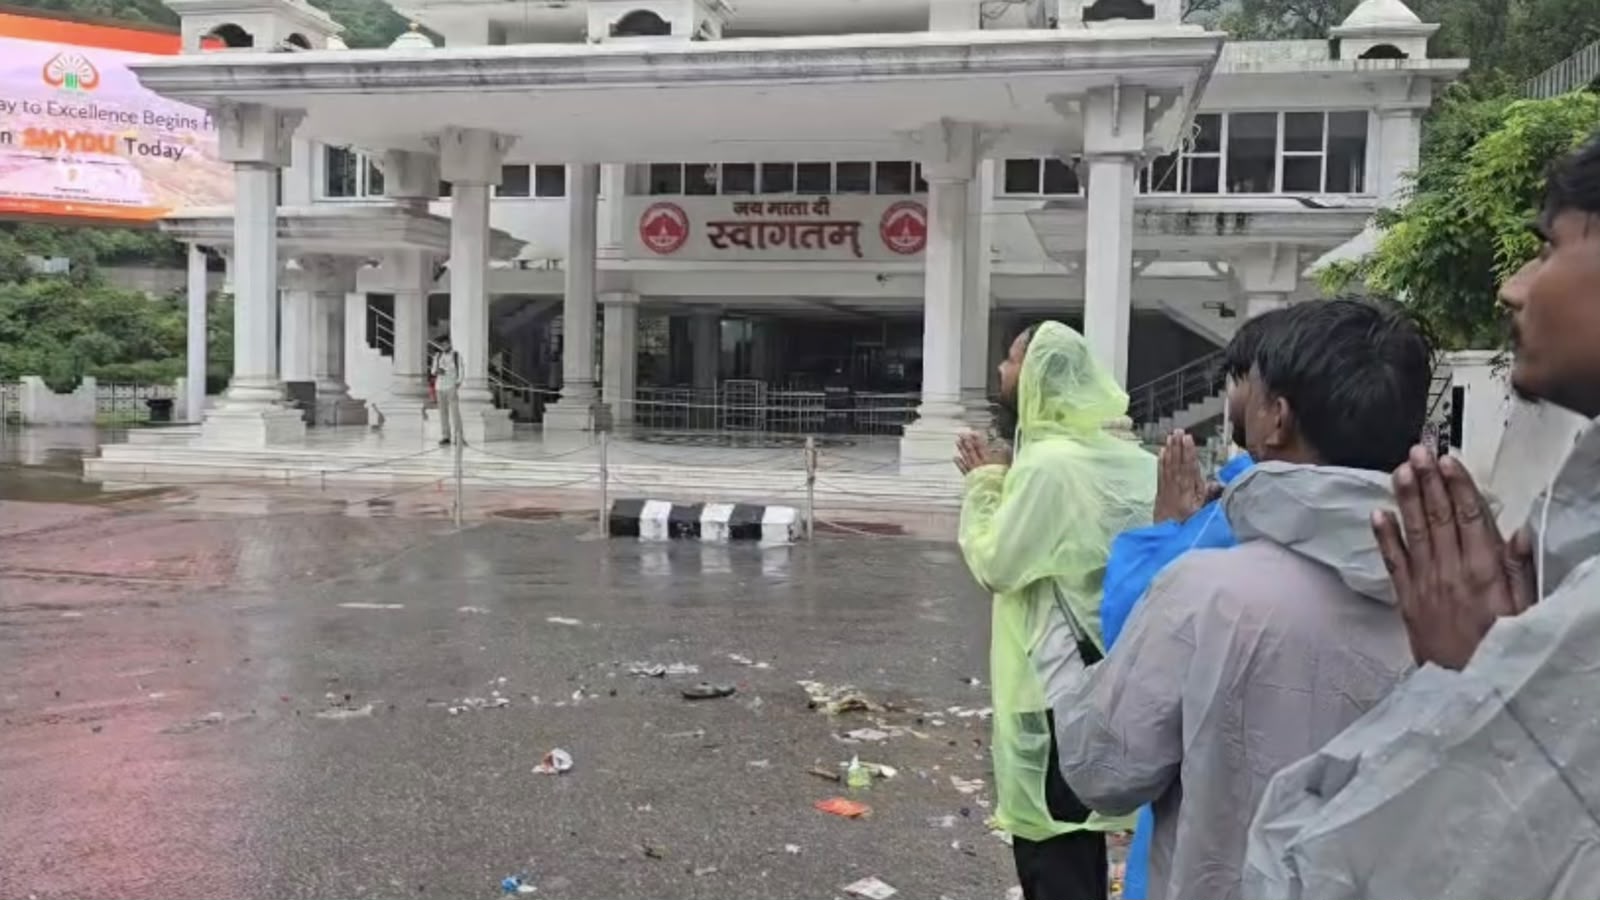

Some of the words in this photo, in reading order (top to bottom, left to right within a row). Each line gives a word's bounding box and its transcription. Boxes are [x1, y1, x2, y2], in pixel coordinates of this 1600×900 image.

[23, 100, 42, 115] to
[47, 101, 139, 125] Excellence
[143, 109, 199, 131] Begins
[22, 127, 117, 153] SMVDU
[123, 136, 186, 163] Today
[733, 201, 763, 216] जय
[767, 201, 808, 216] माता
[812, 196, 831, 216] दी
[706, 220, 864, 258] स्वागतम्
